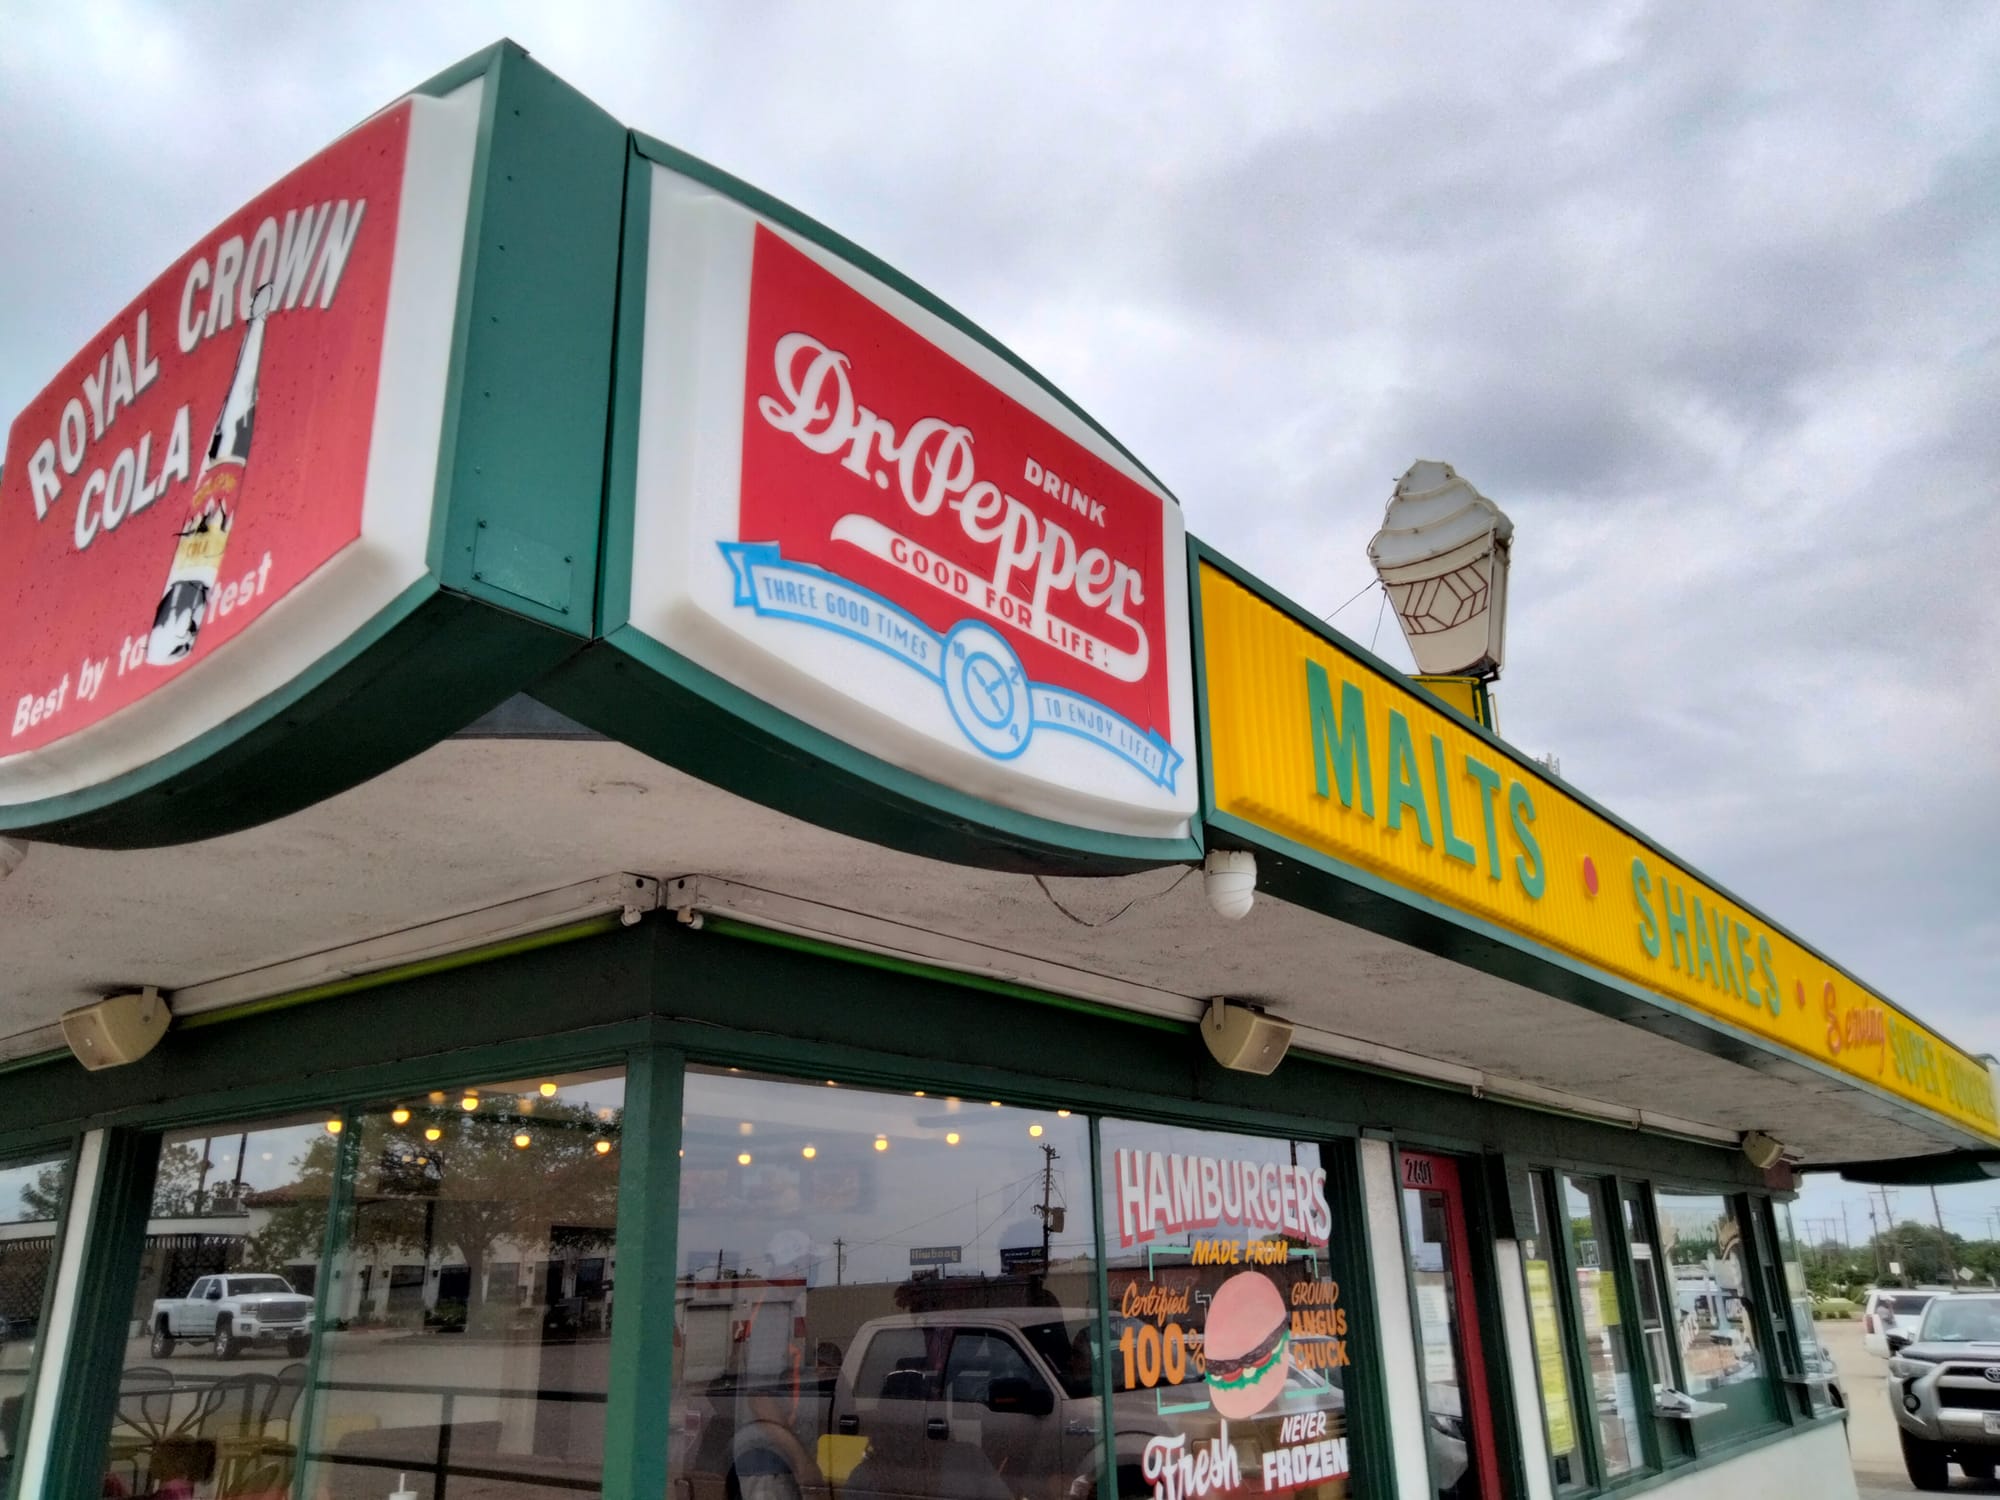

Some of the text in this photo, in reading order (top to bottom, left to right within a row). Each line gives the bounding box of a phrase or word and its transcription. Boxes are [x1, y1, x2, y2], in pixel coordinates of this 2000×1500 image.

[27, 199, 366, 522] ROYAL CROWN
[74, 405, 190, 550] COLA
[758, 331, 1145, 618] Dr. Pepper
[1024, 456, 1108, 528] DRINK
[890, 537, 969, 596] GOOD
[985, 586, 1033, 630] FOR
[763, 577, 928, 660] THREE GOOD TIMES
[952, 640, 966, 661] 10
[11, 672, 69, 737] Best
[77, 656, 109, 701] by
[1009, 666, 1020, 686] 2
[1009, 723, 1020, 742] 4
[1044, 696, 1158, 770] TO ENJOY LIFE!
[1305, 656, 1546, 901] MALTS
[1631, 856, 1782, 1017] SHAKES
[1115, 1148, 1332, 1249] HAMBURGERS
[1192, 1239, 1288, 1266] MADE FROM
[1122, 1281, 1190, 1325] Certified
[1291, 1281, 1339, 1306] GROUND
[1291, 1308, 1347, 1337] ANGUS
[1120, 1322, 1206, 1389] 100%
[1293, 1341, 1350, 1370] CHUCK
[1142, 1419, 1242, 1500] Fresh
[1280, 1411, 1327, 1444] NEVER
[1262, 1438, 1350, 1491] FROZEN
